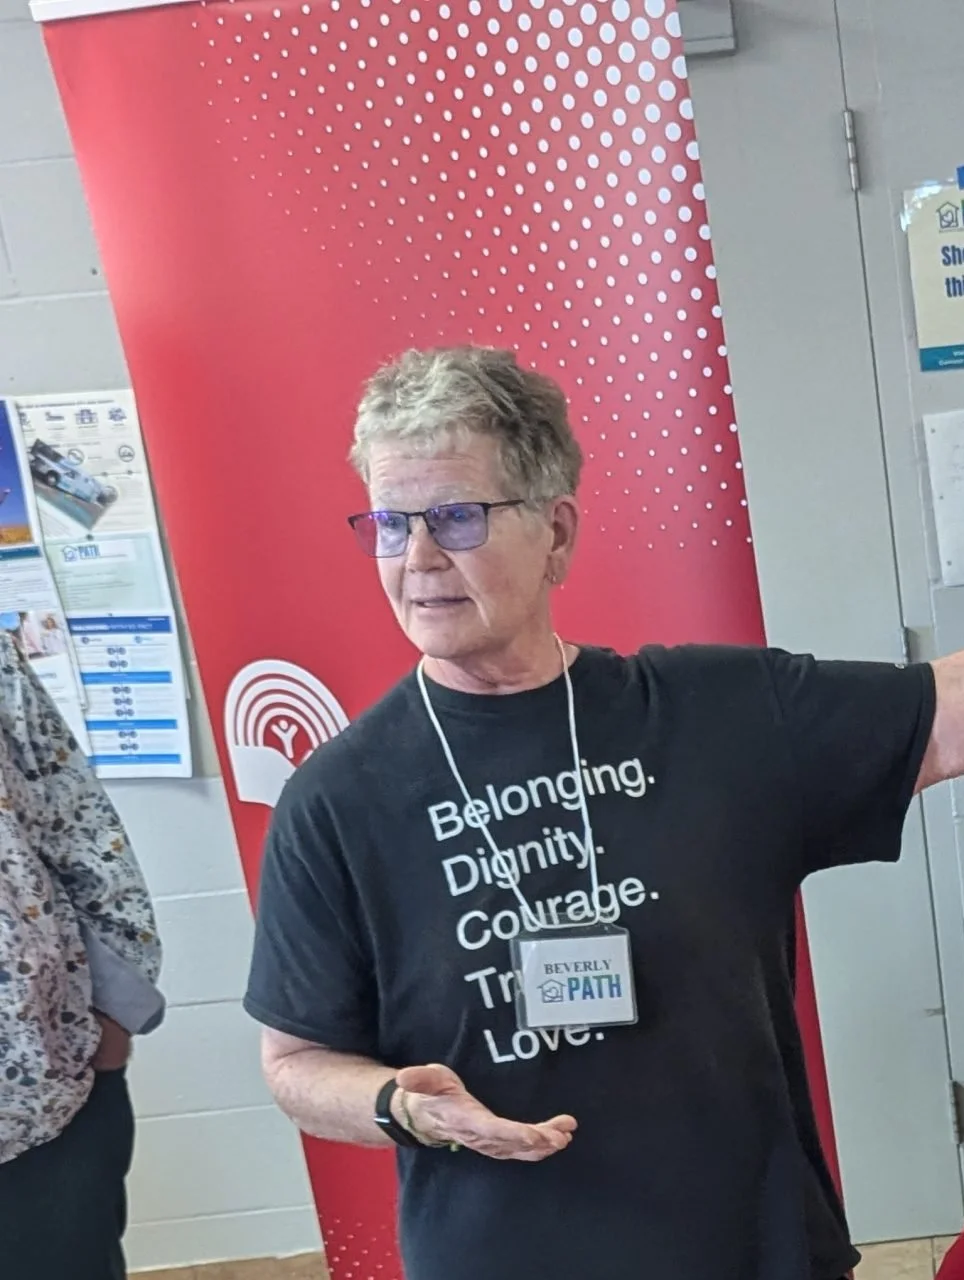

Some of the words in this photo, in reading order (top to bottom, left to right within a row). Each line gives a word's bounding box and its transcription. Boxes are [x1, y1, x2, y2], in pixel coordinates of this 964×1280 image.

[427, 758, 655, 841] Belonging.
[442, 827, 604, 896] Dignity.
[456, 877, 659, 950] Courage.
[544, 960, 611, 974] BEVERLY
[567, 974, 622, 1001] PATH
